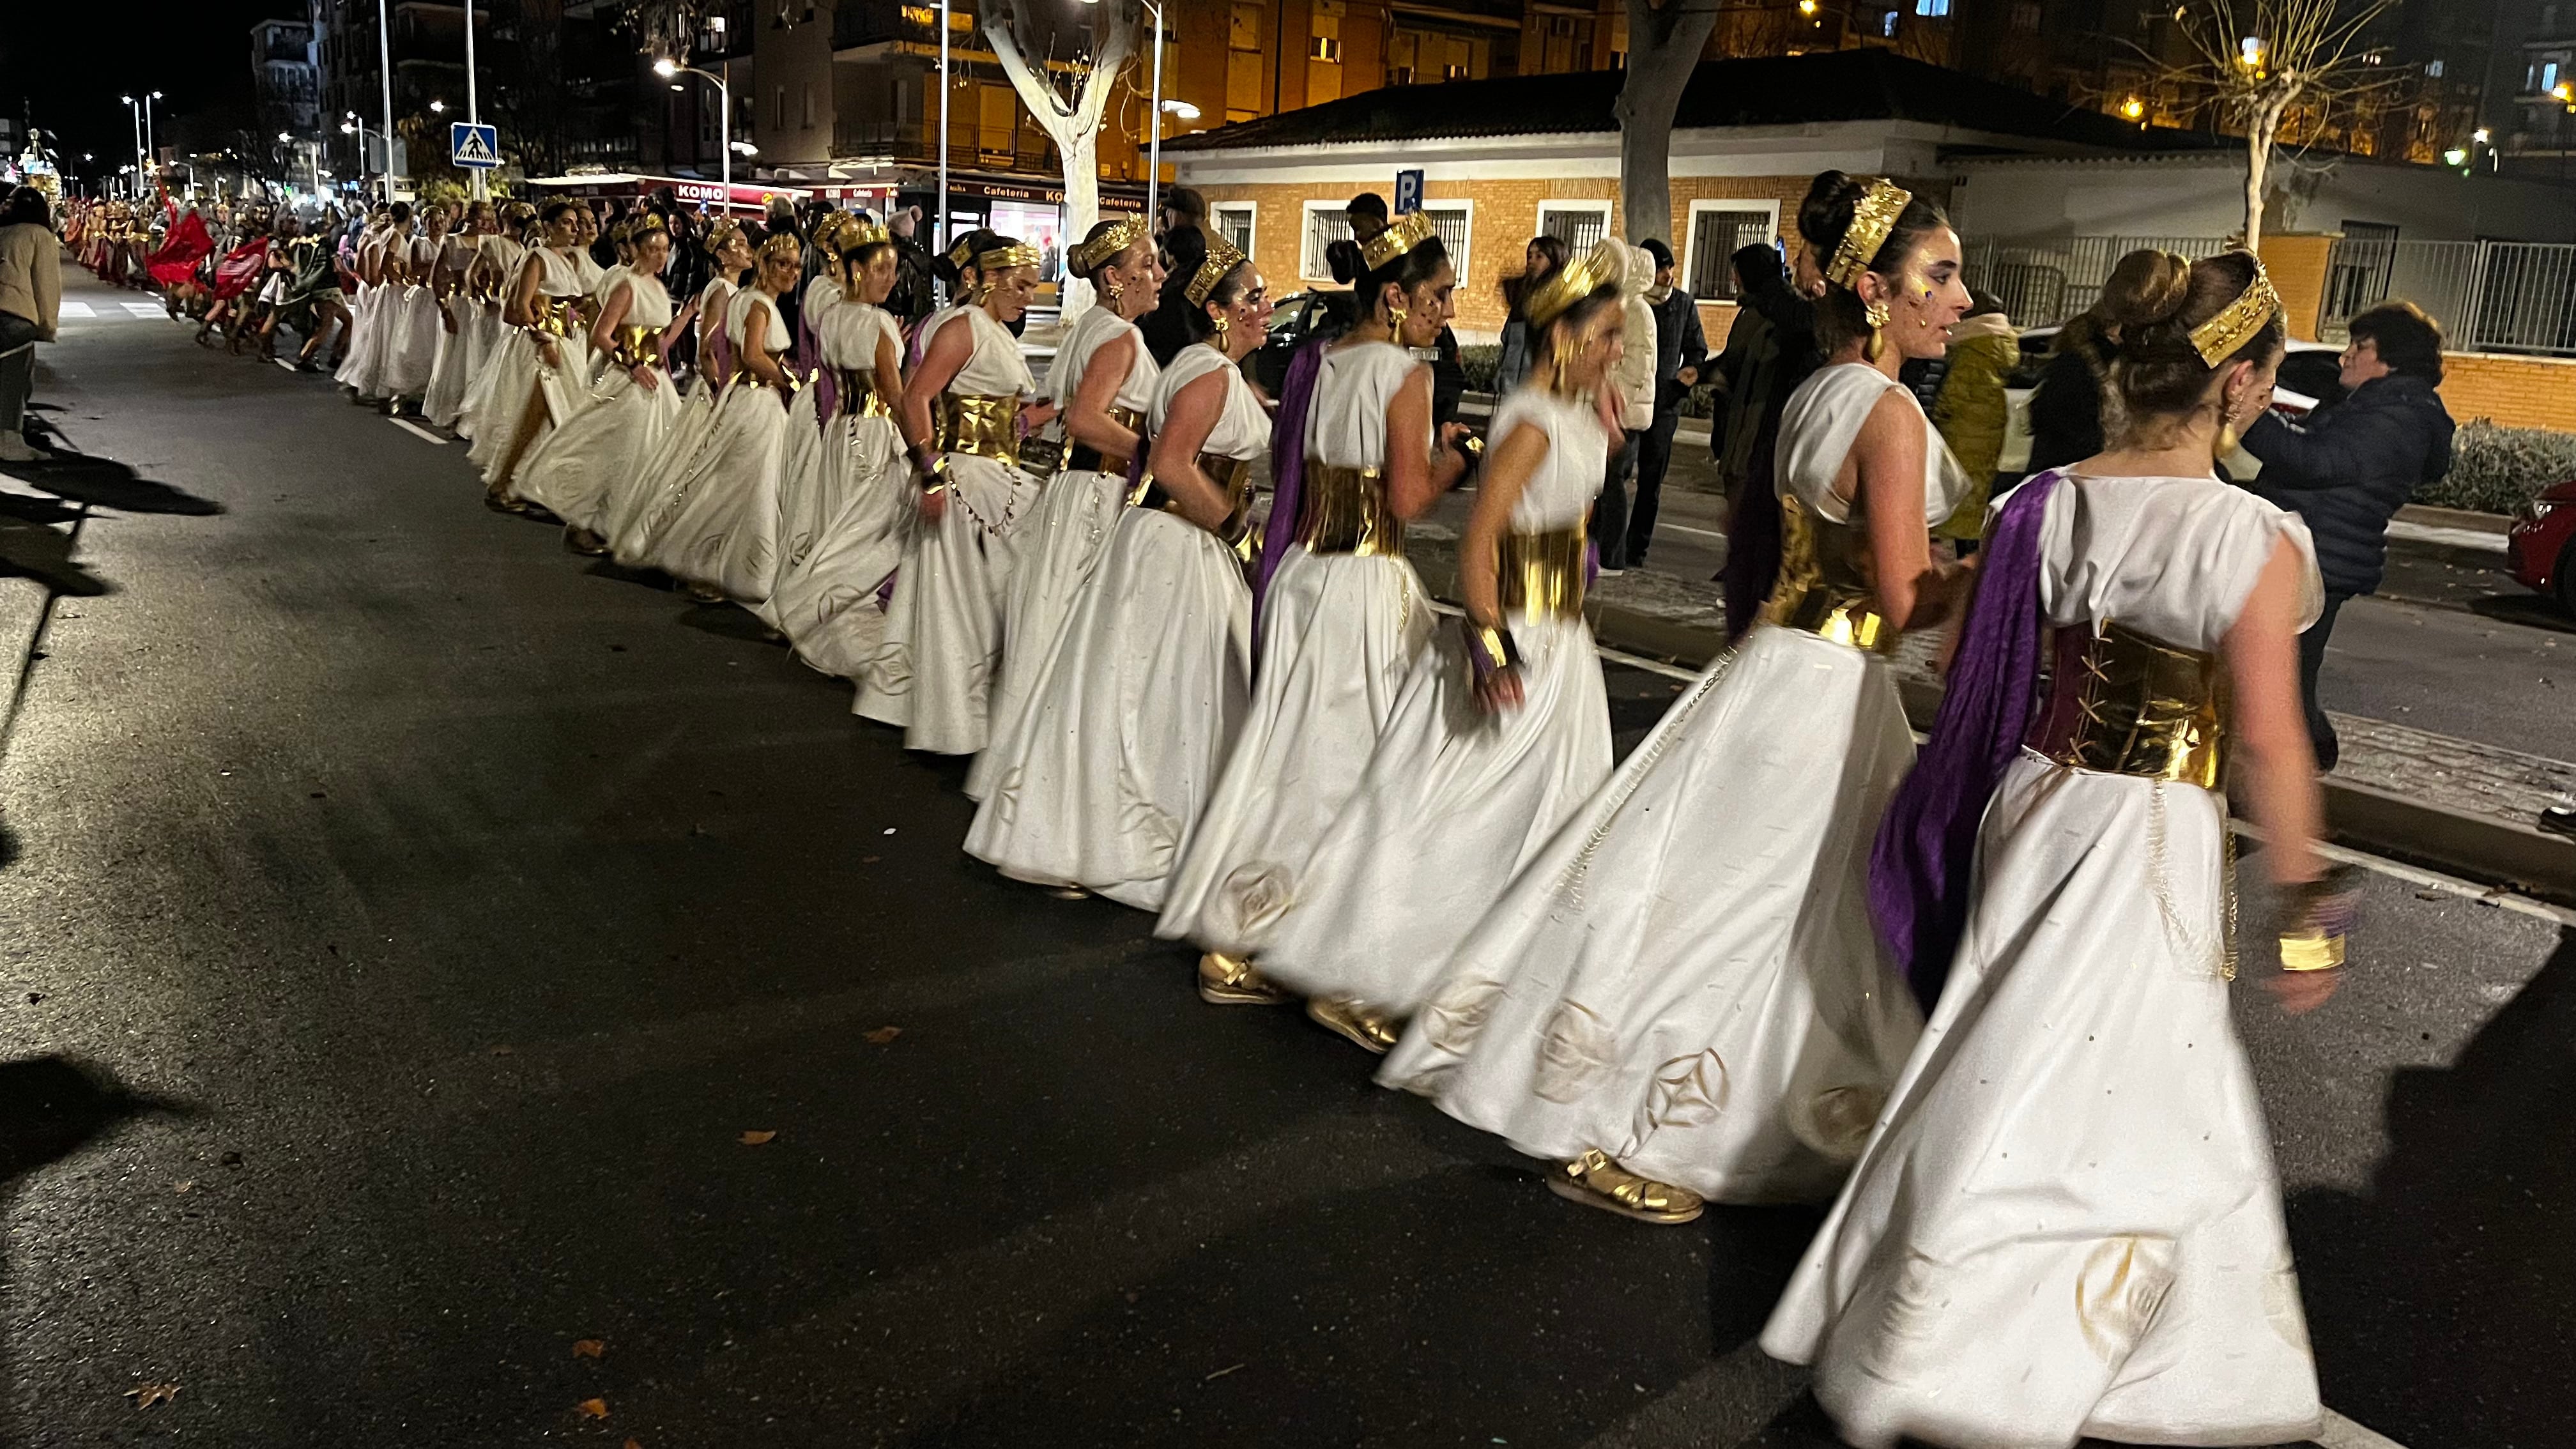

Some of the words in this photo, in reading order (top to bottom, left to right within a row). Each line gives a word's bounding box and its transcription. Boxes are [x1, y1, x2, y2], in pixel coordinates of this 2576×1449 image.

[678, 185, 723, 200] KOMO
[984, 186, 1029, 198] Cafeteria
[1046, 191, 1063, 202] KO
[1099, 197, 1141, 208] Cafeteria
[1399, 174, 1416, 210] P
